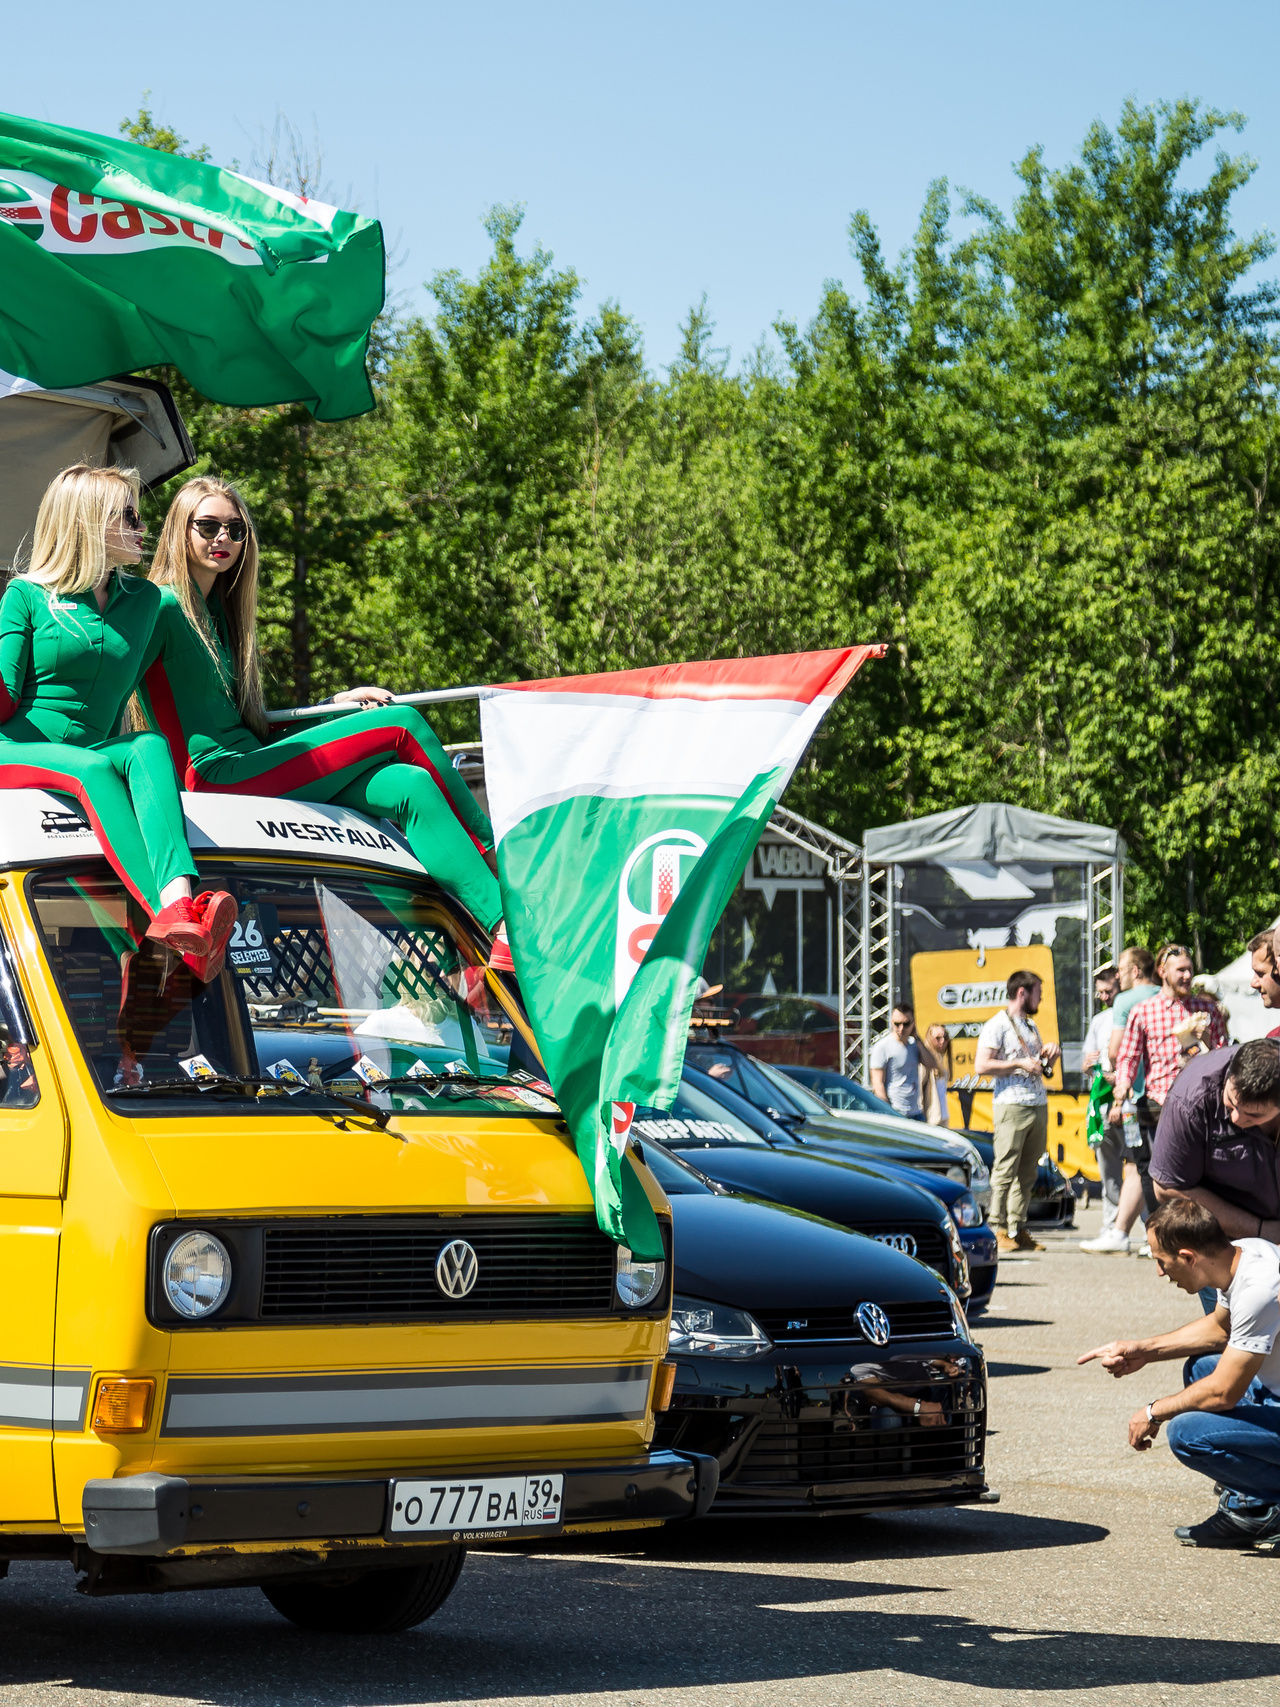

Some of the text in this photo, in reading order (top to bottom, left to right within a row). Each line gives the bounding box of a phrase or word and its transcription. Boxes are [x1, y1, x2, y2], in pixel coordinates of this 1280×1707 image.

[256, 820, 397, 852] WESTFALIA
[229, 920, 263, 947] 26
[230, 949, 271, 964] SELECTED
[527, 1479, 553, 1509] 39
[523, 1509, 542, 1520] RUS
[462, 1530, 508, 1539] VOLKSWAGEN
